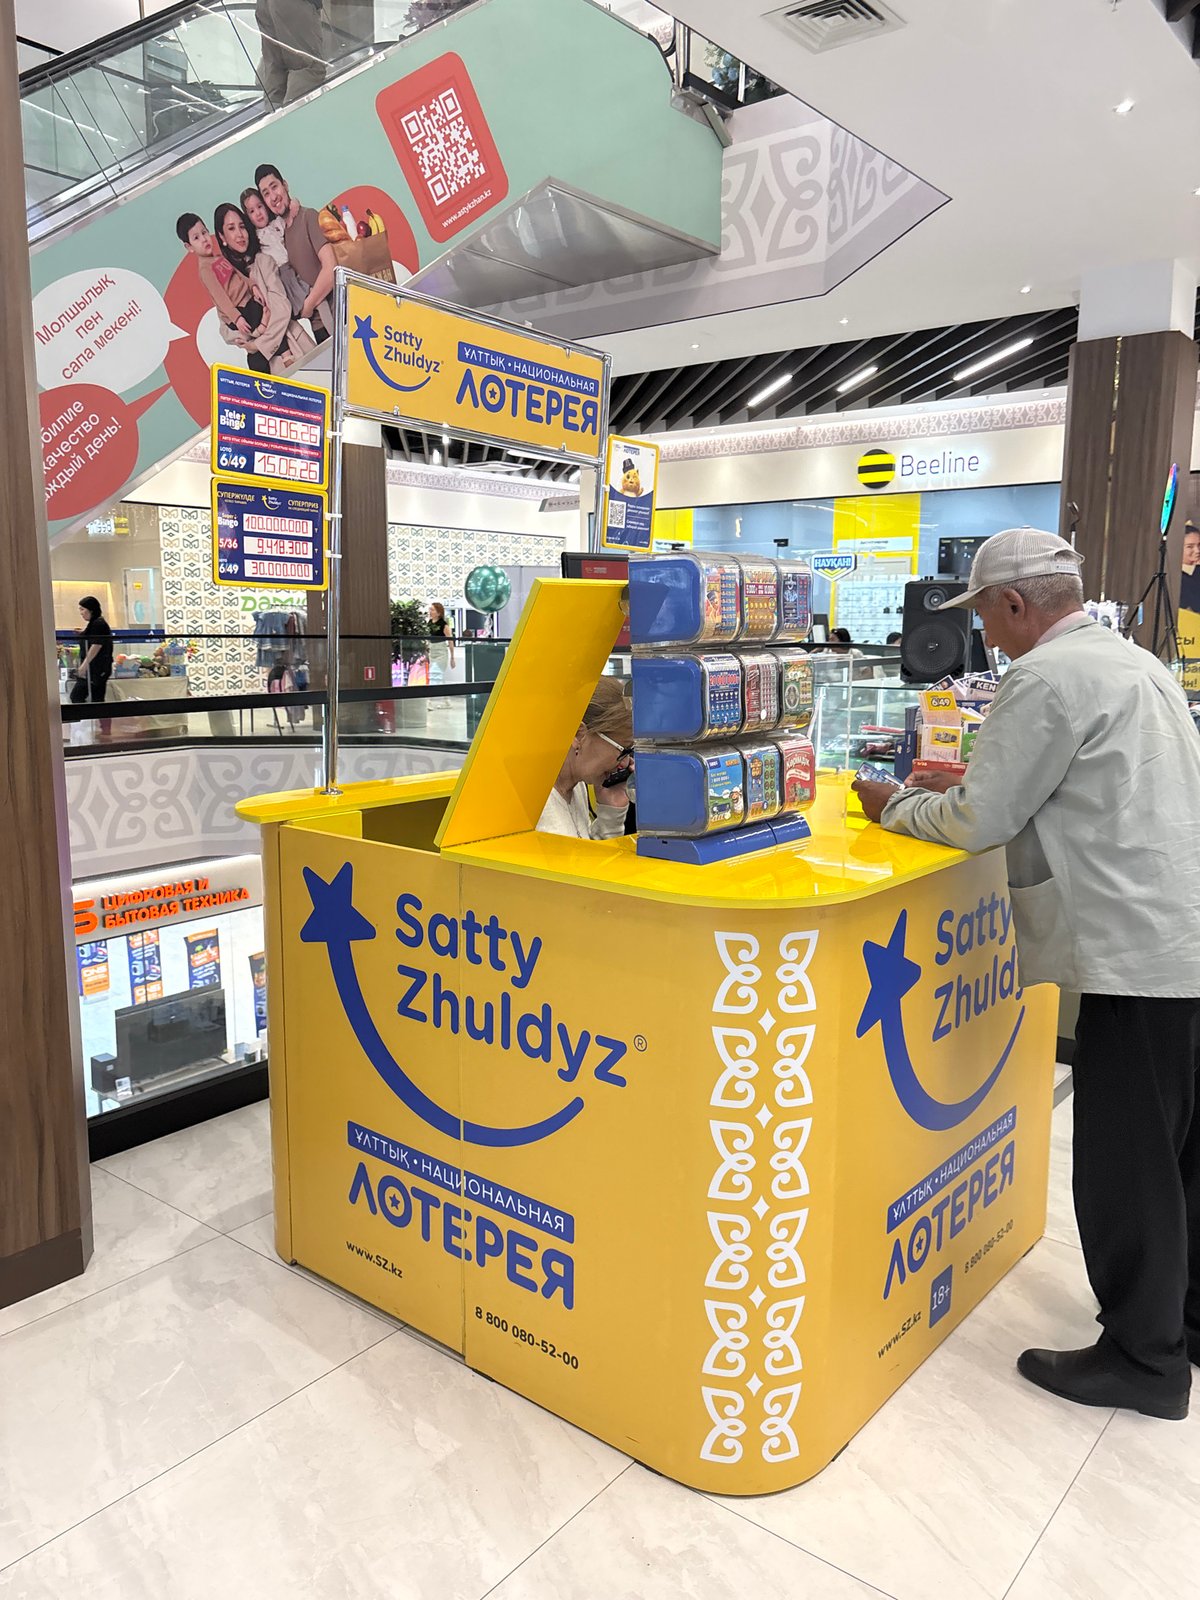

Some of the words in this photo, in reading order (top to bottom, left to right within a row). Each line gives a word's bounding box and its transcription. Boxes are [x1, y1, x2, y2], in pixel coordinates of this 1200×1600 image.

[35, 273, 116, 345] Молшылық
[75, 310, 104, 339] пен
[62, 346, 96, 379] сапа
[94, 299, 143, 350] мекені!
[384, 325, 423, 352] Satty
[383, 345, 440, 373] Zhuldyz
[463, 346, 505, 368] ҰЛТТЫҚ
[513, 361, 596, 394] НАЦИОНАЛЬНАЯ
[224, 409, 240, 419] Tele
[456, 368, 599, 436] ЛОТЕРЕЯ
[41, 401, 84, 448] билие
[220, 415, 246, 430] Bingo
[45, 453, 86, 502] ждый
[84, 416, 122, 460] день!
[220, 453, 247, 468] 6/49
[257, 455, 318, 480] 15.06.26
[901, 451, 979, 477] Beeline
[218, 516, 239, 528] Bingo
[287, 499, 319, 509] СУПЕРПРИЗ
[219, 539, 238, 549] 5/36
[257, 538, 309, 555] 9.418.300
[814, 555, 852, 569] НАУҚАН!
[219, 563, 239, 574] 6/49
[976, 681, 997, 692] KEN
[103, 880, 194, 911] ЦИФРОВАЯ
[198, 877, 209, 891] И
[104, 901, 180, 930] БЫТОВАЯ
[183, 887, 251, 913] ТЕХНИКА
[395, 893, 543, 989] Satty
[934, 891, 1012, 966] Satty
[932, 945, 1023, 1043] Zhuld
[397, 964, 628, 1087] Zhuldyz
[354, 1128, 410, 1168] ҰЛТТЫҚ
[421, 1159, 565, 1233] НАЦИОНАЛЬНАЯ
[892, 1181, 932, 1221] ҰЛТТЫҚ
[939, 1112, 1013, 1185] НАЦИОНАЛЬНАЯ
[349, 1161, 575, 1311] ЛОТЕРЕЯ
[883, 1139, 1015, 1301] ЛОТЕРЕЯ
[346, 1240, 403, 1279] www.SZ.kz
[931, 1284, 951, 1311] 18+
[475, 1306, 483, 1320] 8
[486, 1311, 509, 1332] 800
[511, 1325, 579, 1370] 080-52-00
[877, 1311, 922, 1359] www.SZ.kz
